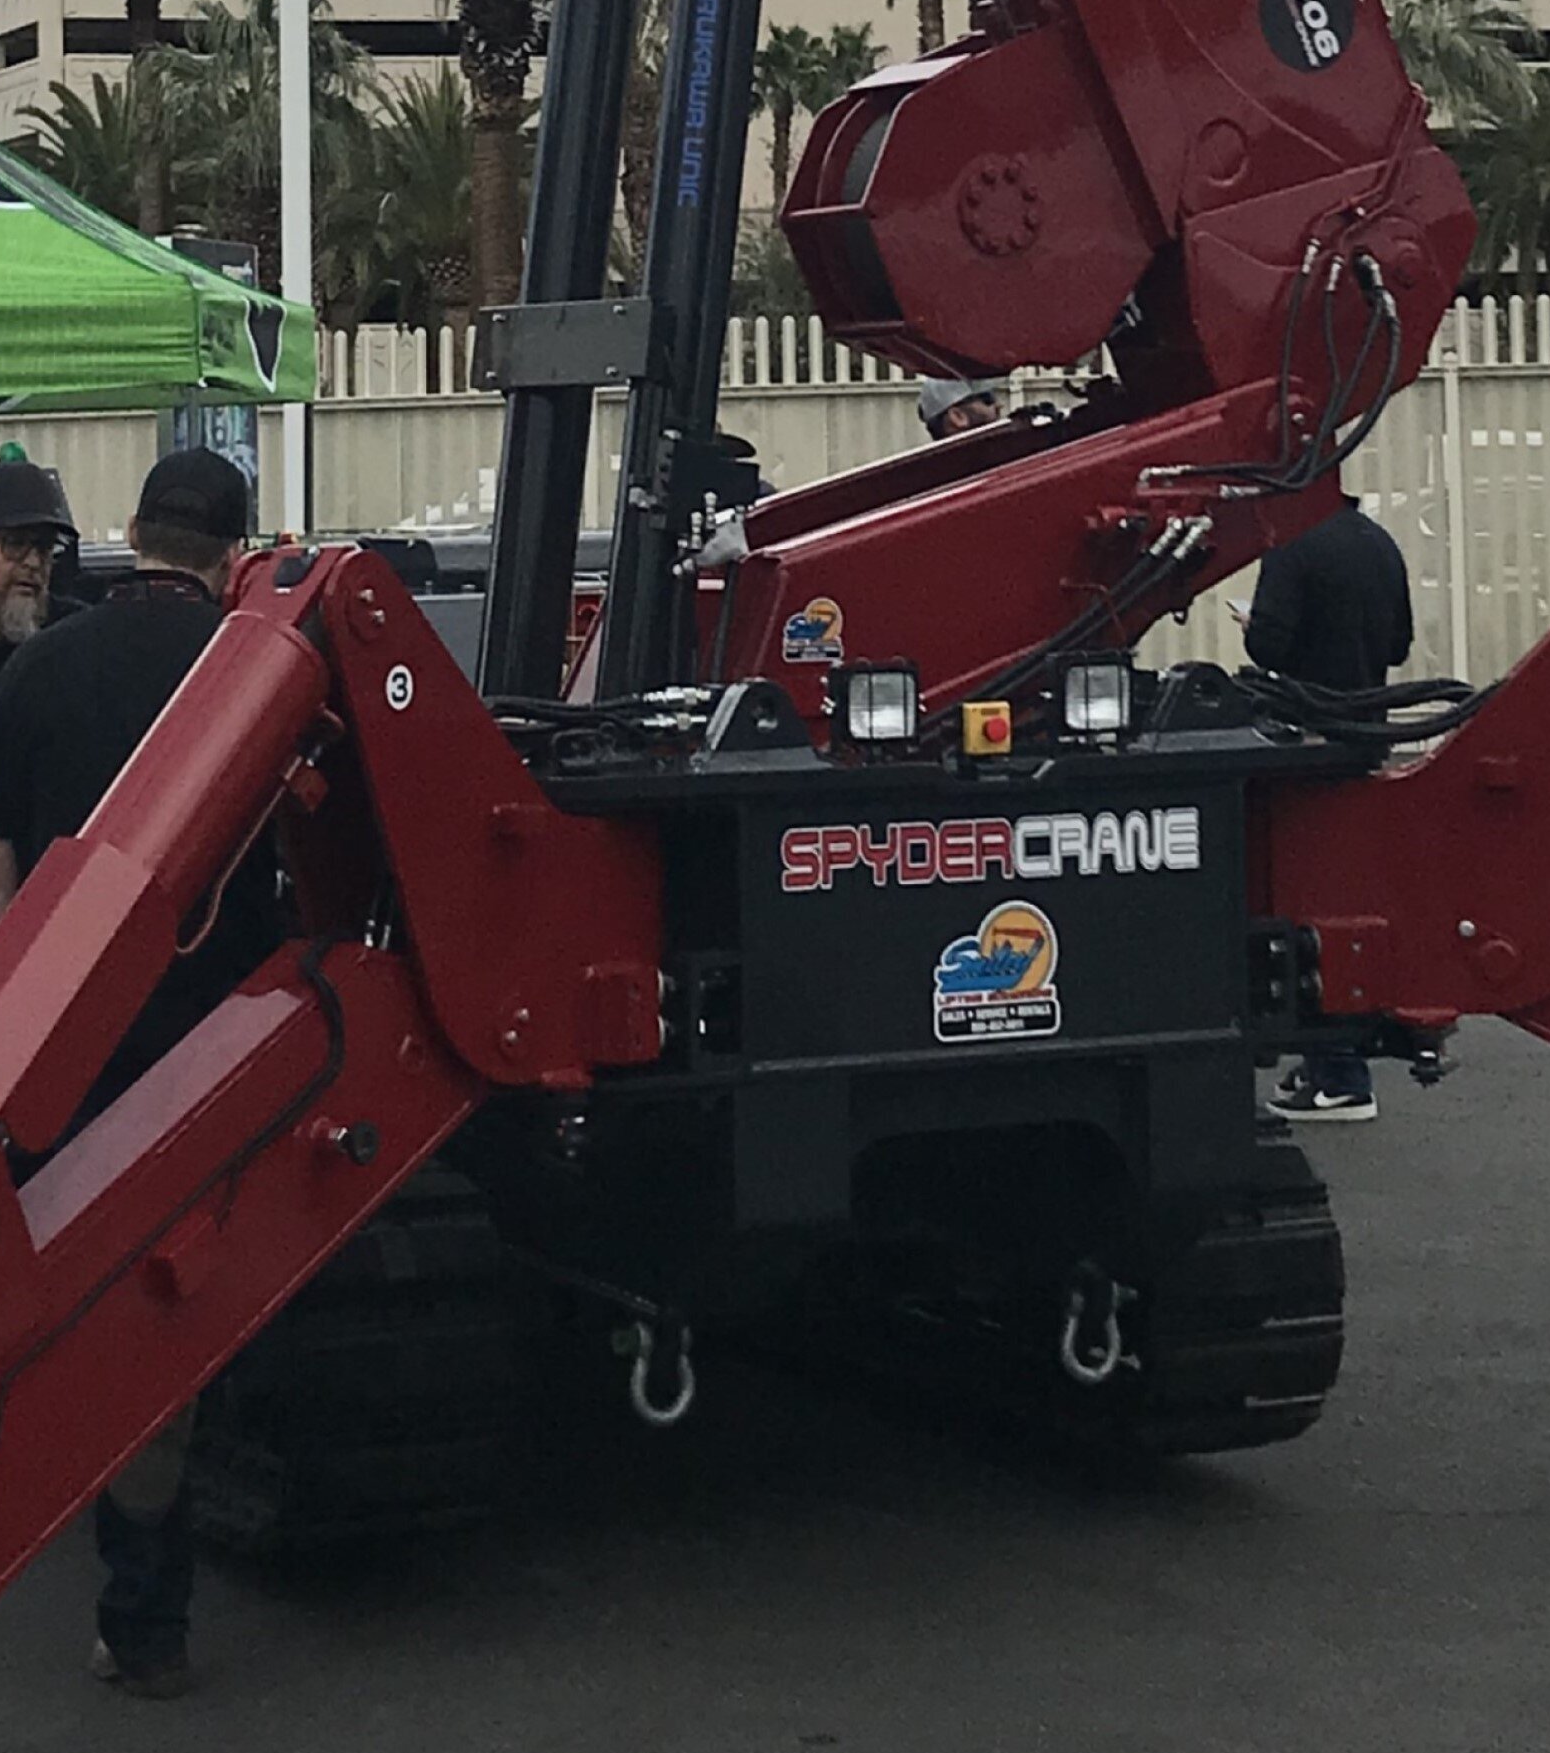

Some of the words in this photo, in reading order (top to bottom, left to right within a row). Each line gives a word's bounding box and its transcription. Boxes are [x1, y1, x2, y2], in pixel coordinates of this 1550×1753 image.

[676, 137, 706, 209] UNIC
[391, 671, 409, 703] 3
[781, 805, 1200, 892] SPYDERCRANE
